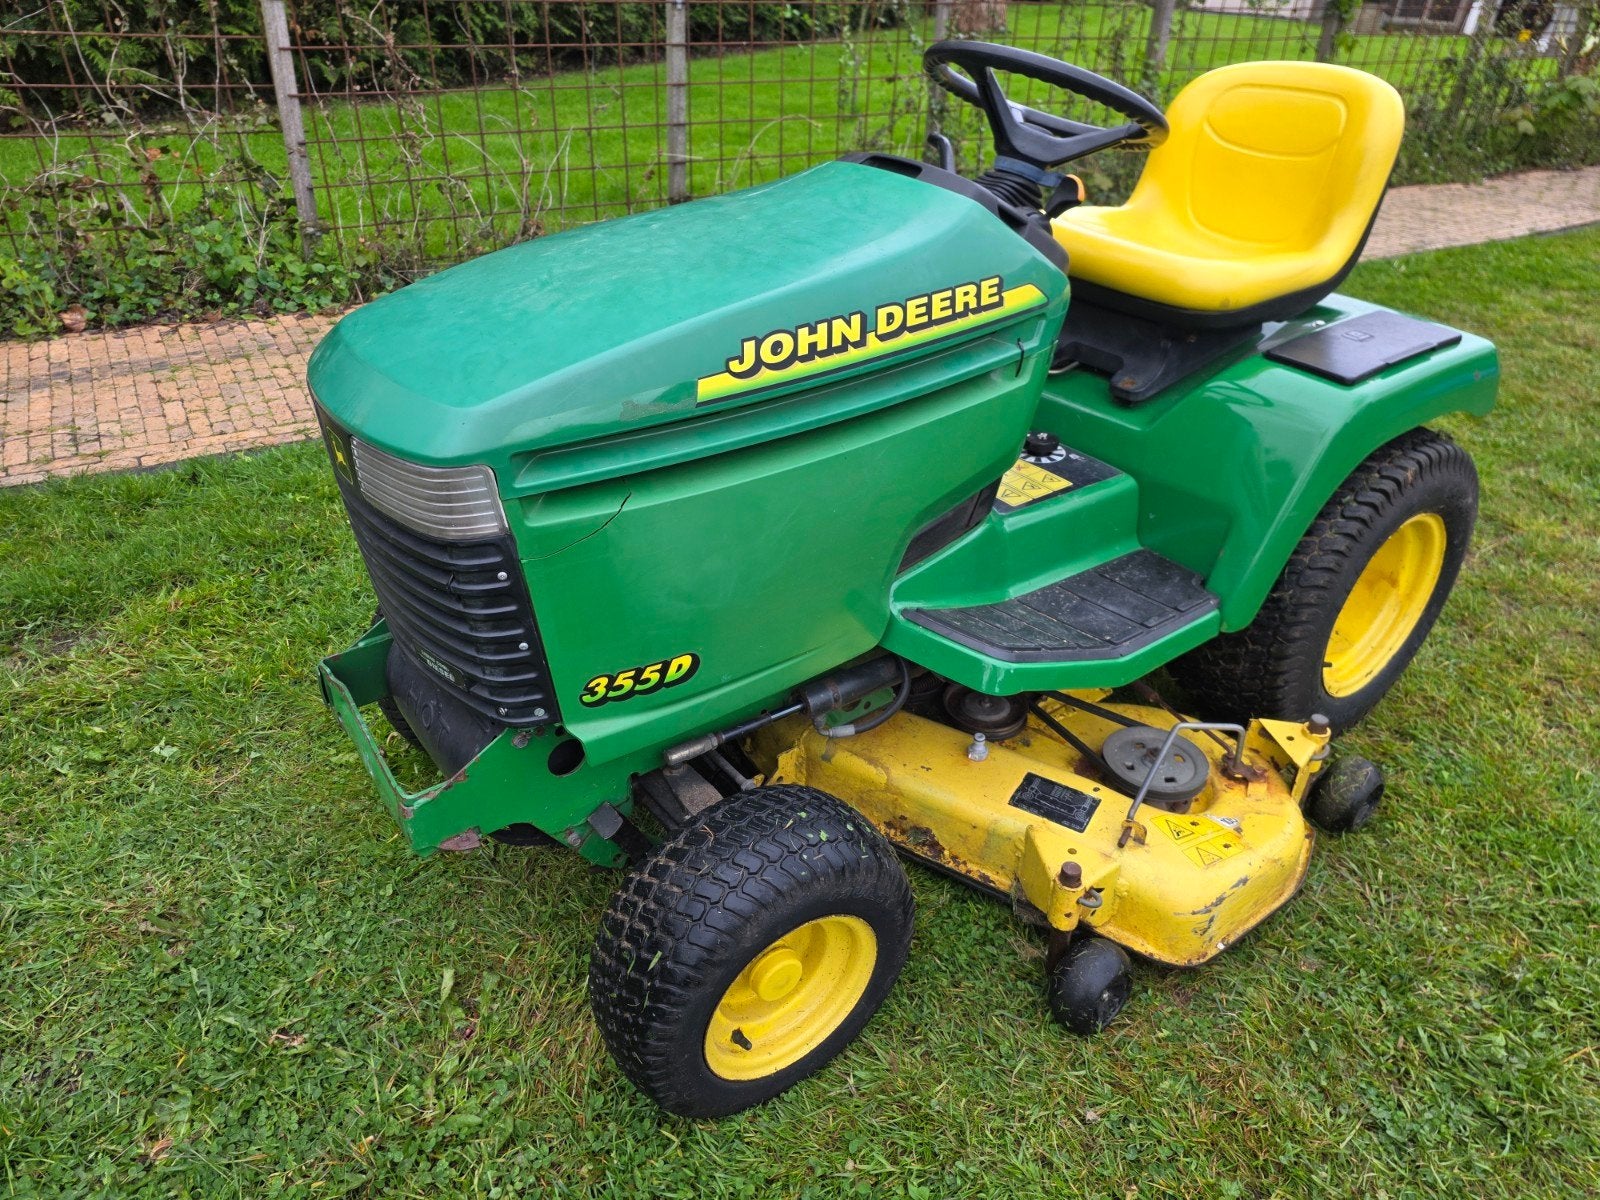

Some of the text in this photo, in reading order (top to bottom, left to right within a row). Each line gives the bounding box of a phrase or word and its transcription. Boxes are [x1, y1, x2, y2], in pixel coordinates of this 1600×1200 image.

[726, 276, 1002, 377] JOHN DEERE
[580, 653, 697, 705] 355D
